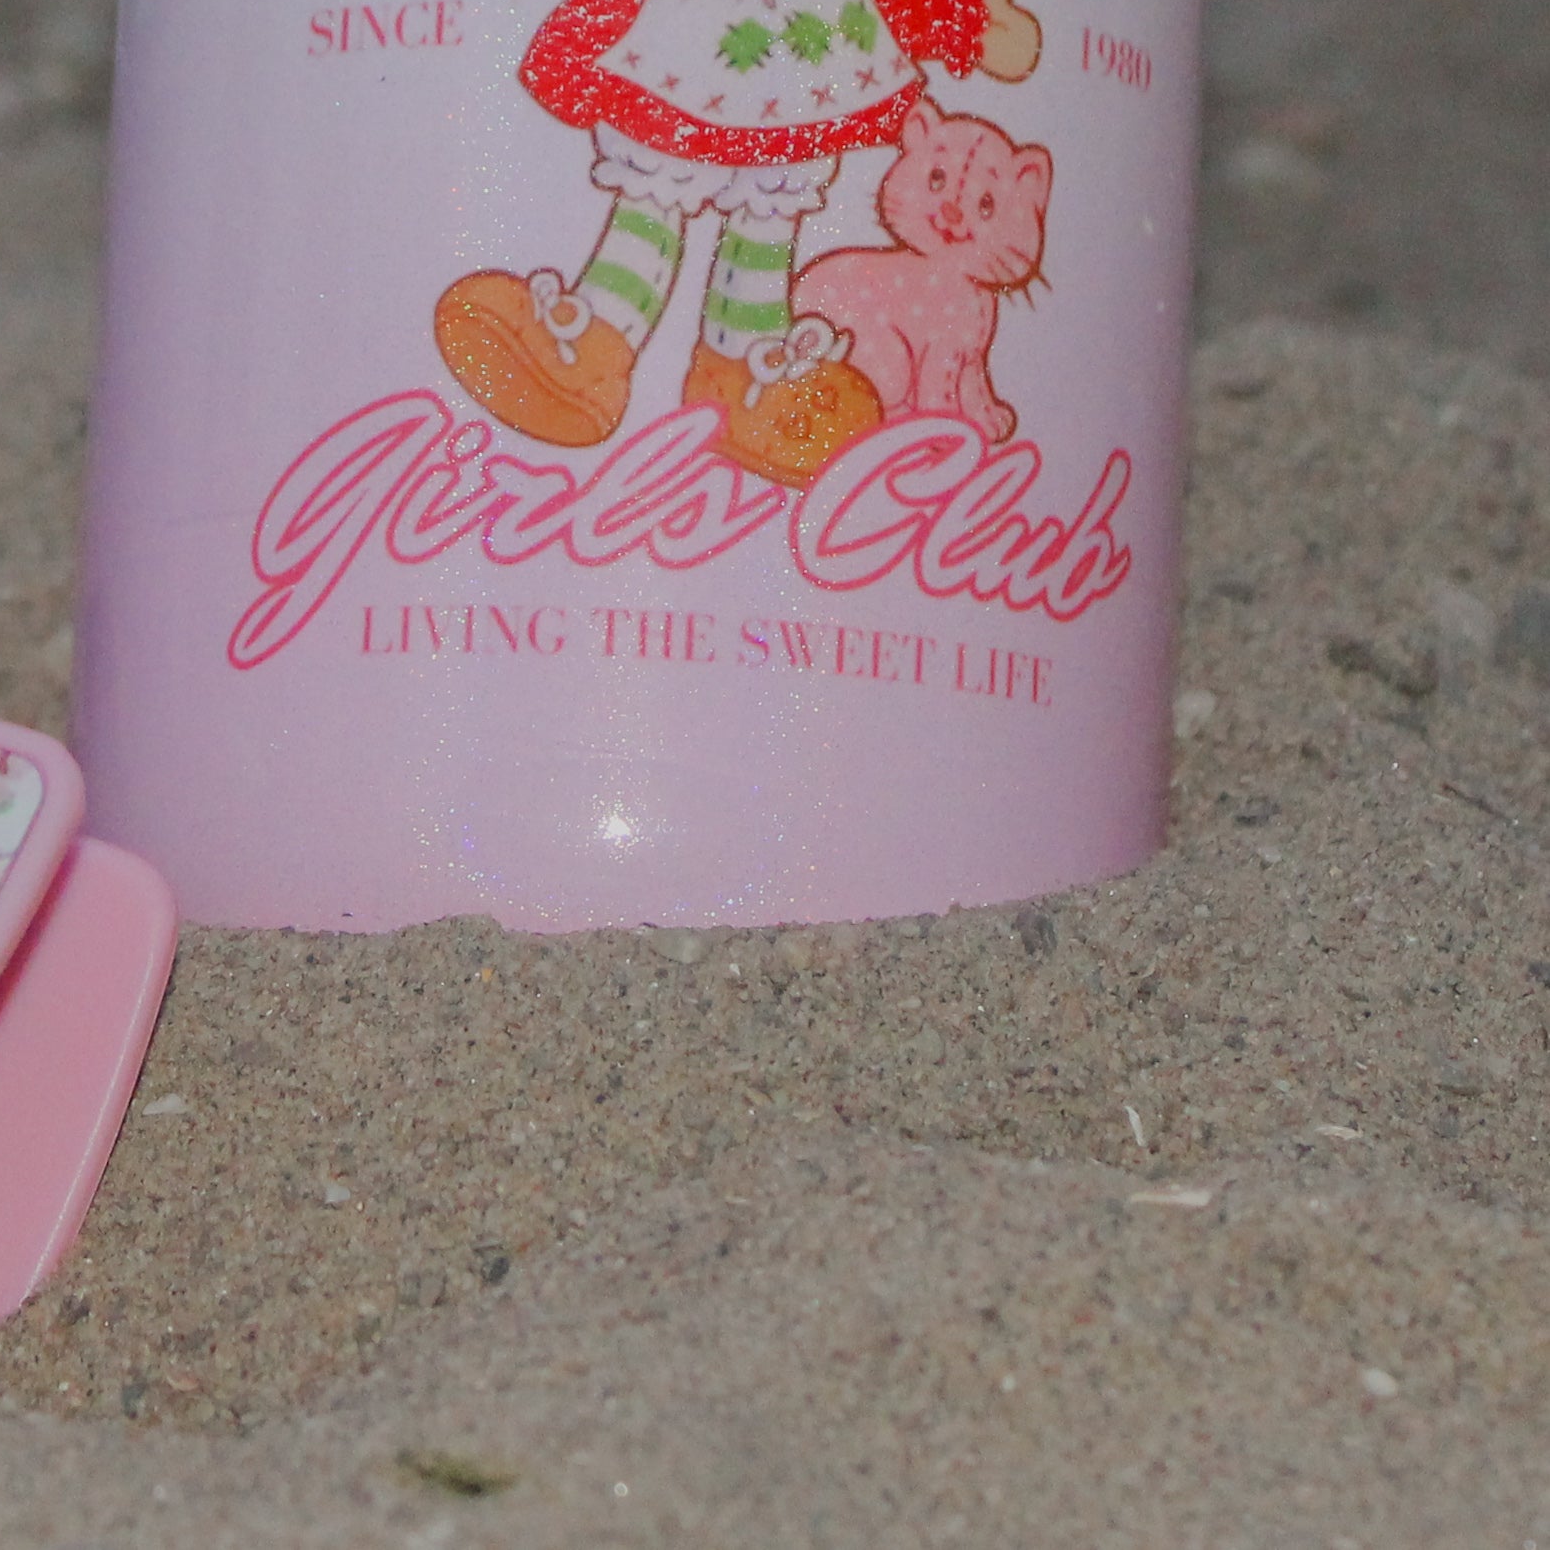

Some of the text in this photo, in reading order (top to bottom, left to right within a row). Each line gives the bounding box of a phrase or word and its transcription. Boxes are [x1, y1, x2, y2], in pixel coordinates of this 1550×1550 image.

[307, 0, 1152, 92] SINCE 1980
[788, 408, 1133, 623] Club
[361, 604, 1054, 707] LIVING THE SWEET LIFE
